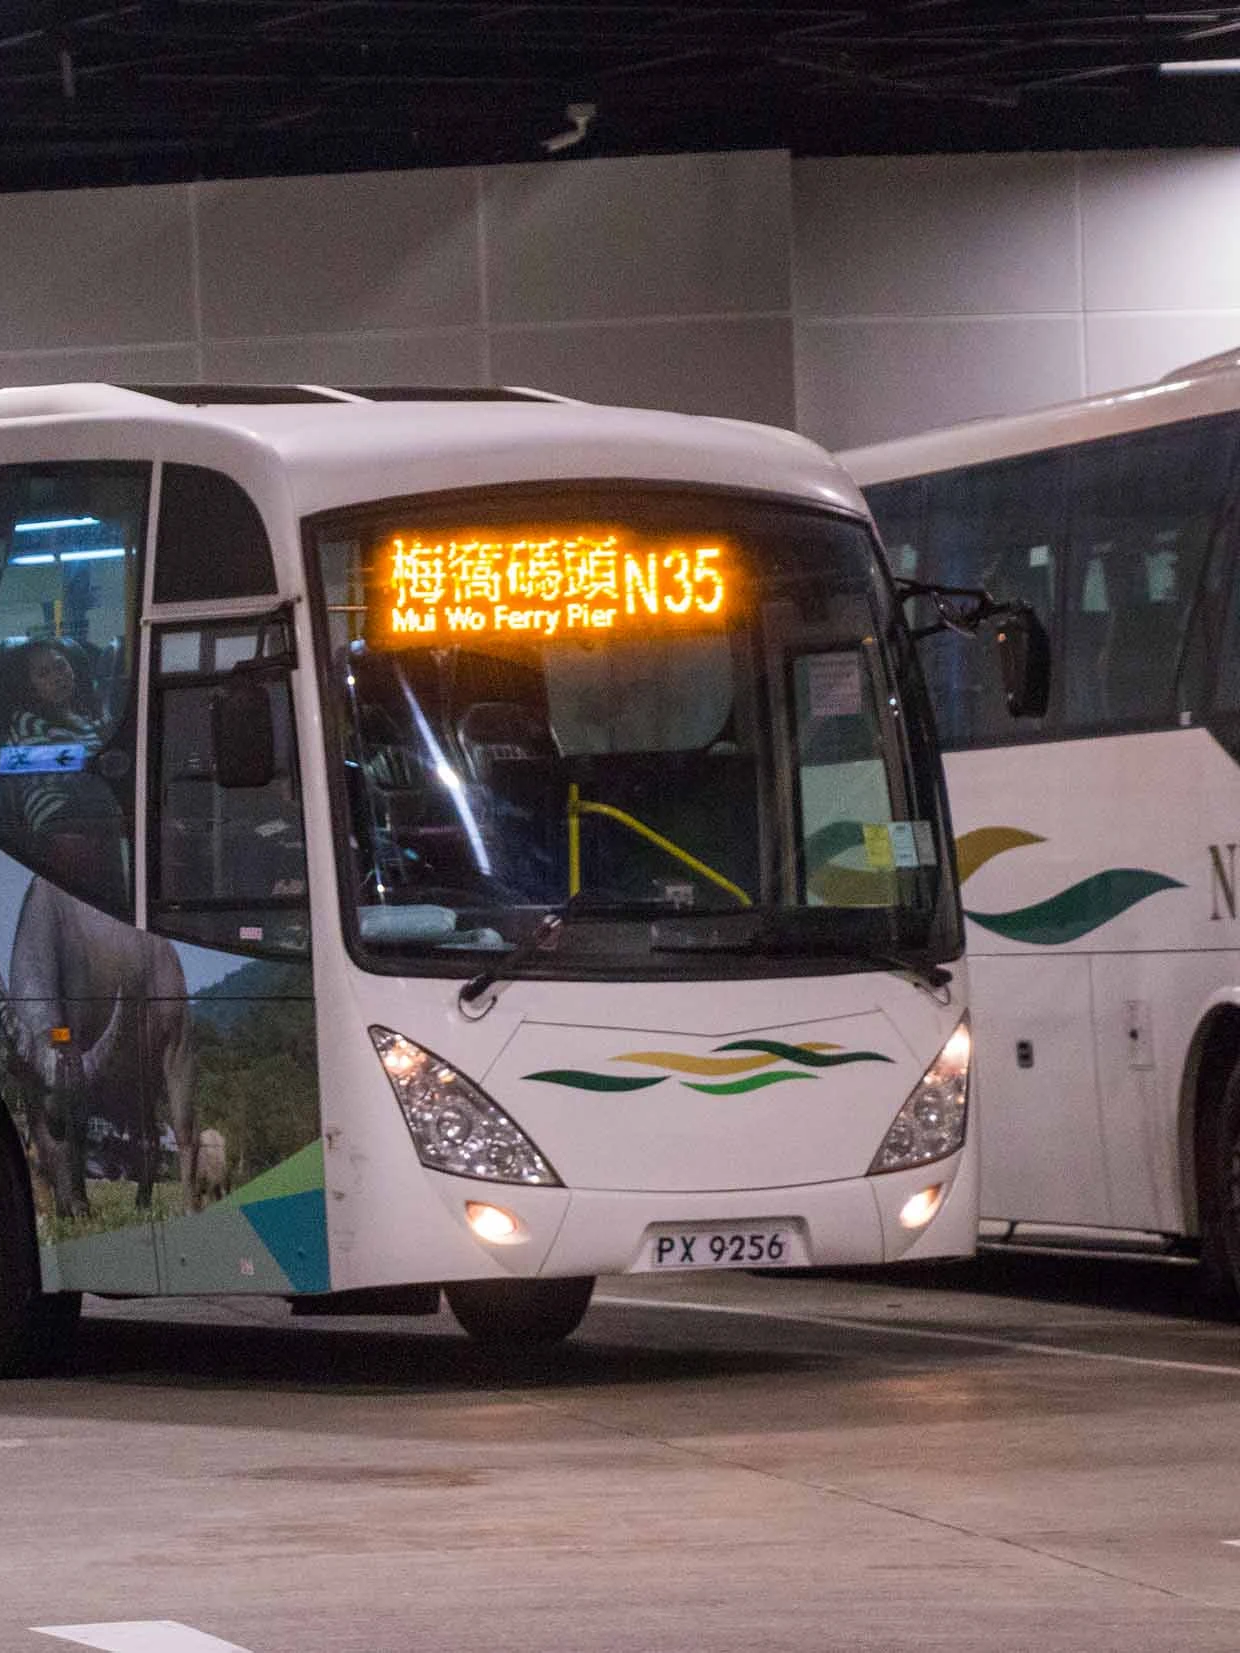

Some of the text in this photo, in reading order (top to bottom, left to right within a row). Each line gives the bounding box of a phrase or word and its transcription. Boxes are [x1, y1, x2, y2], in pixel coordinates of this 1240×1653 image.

[391, 536, 620, 608] 梅窩碼頭
[624, 548, 725, 616] N35
[392, 604, 617, 635] Mui Wo Ferry Pier
[657, 1232, 785, 1264] PX 9256
